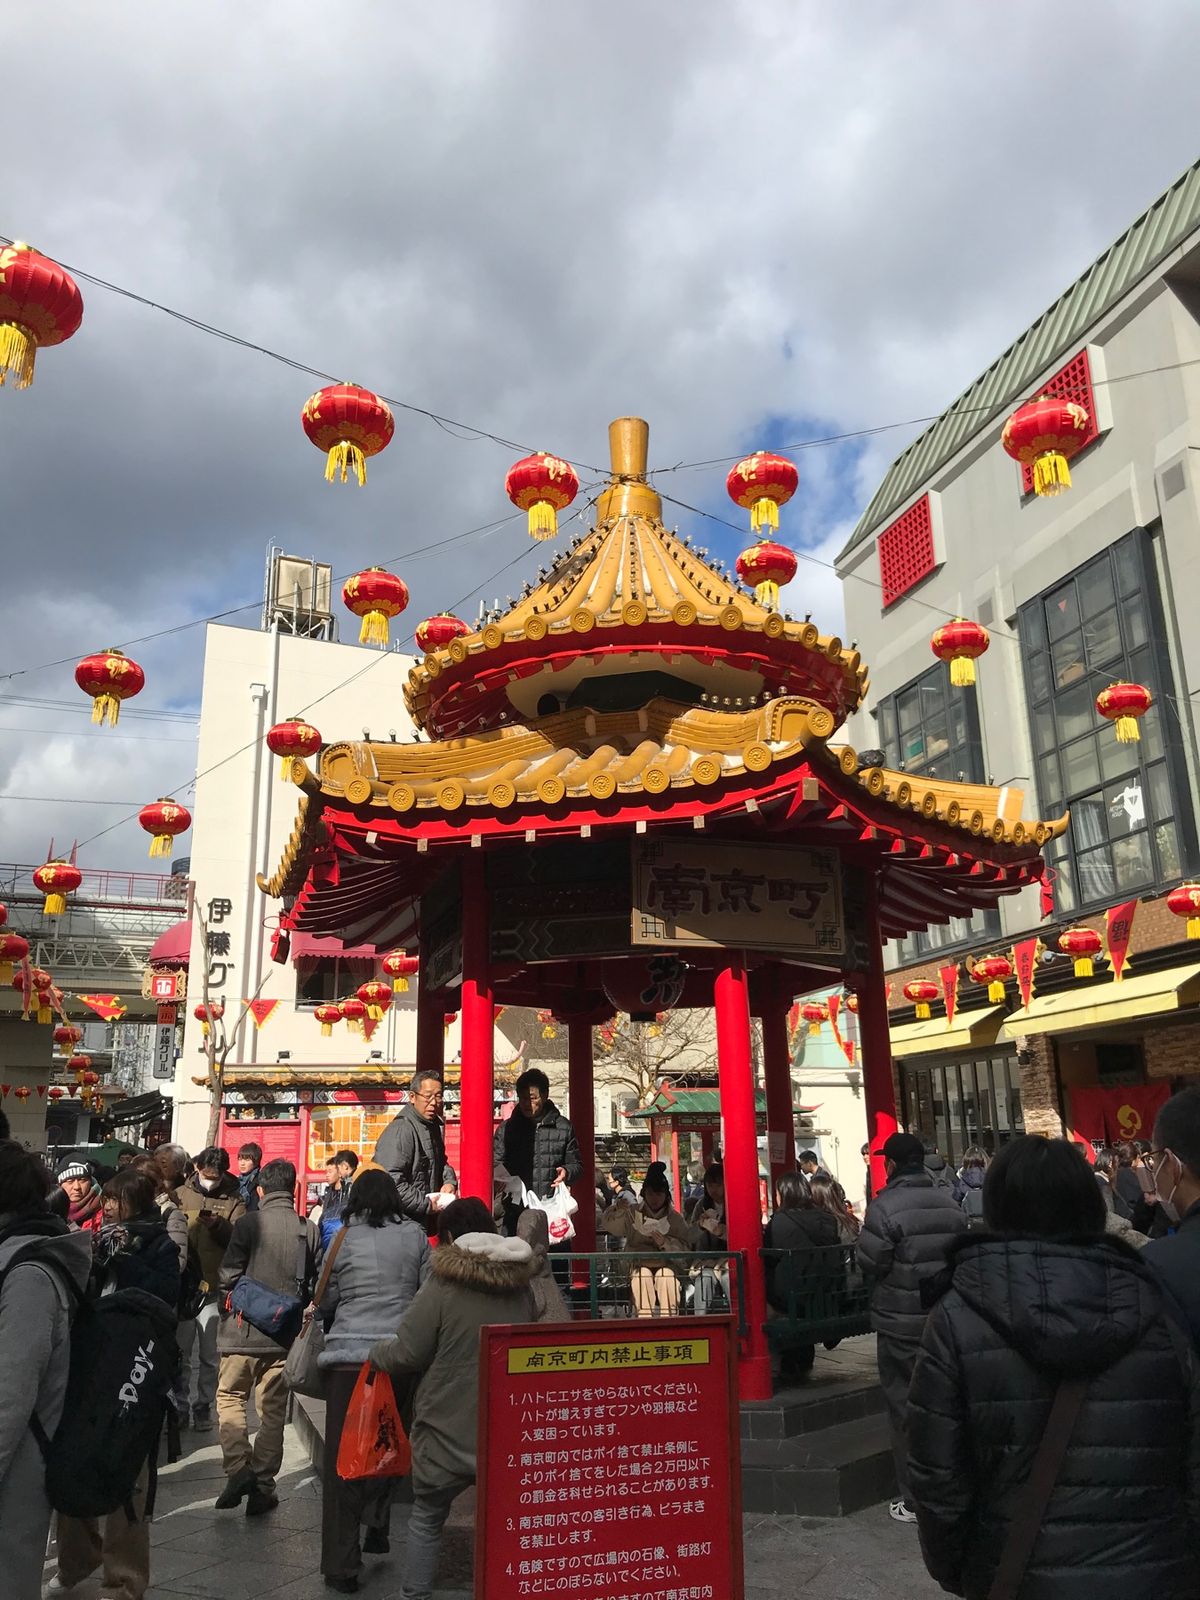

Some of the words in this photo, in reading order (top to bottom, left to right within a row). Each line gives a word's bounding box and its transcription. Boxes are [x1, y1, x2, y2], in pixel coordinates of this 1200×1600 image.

[646, 862, 829, 920] 南京町
[526, 1344, 694, 1368] 南京町内禁止事項
[521, 1399, 699, 1423] ハトが増えすぎてフンや羽根など
[520, 1440, 699, 1467] 南京町内ではポイ捨て禁止条例に
